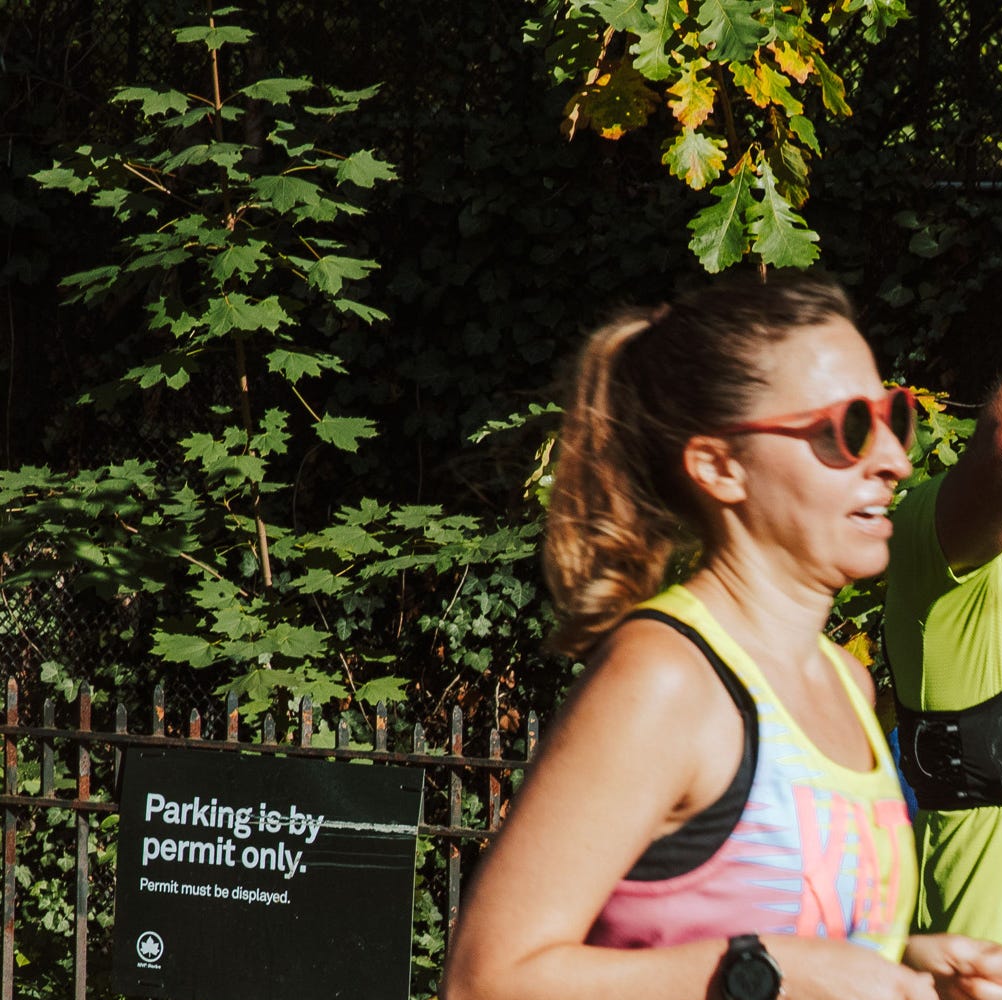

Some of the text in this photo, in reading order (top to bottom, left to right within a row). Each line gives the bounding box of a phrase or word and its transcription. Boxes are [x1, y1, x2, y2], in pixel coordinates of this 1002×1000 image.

[145, 793, 324, 843] Parking is by
[142, 837, 306, 879] permit only.
[140, 877, 290, 905] Permit must be displayed.
